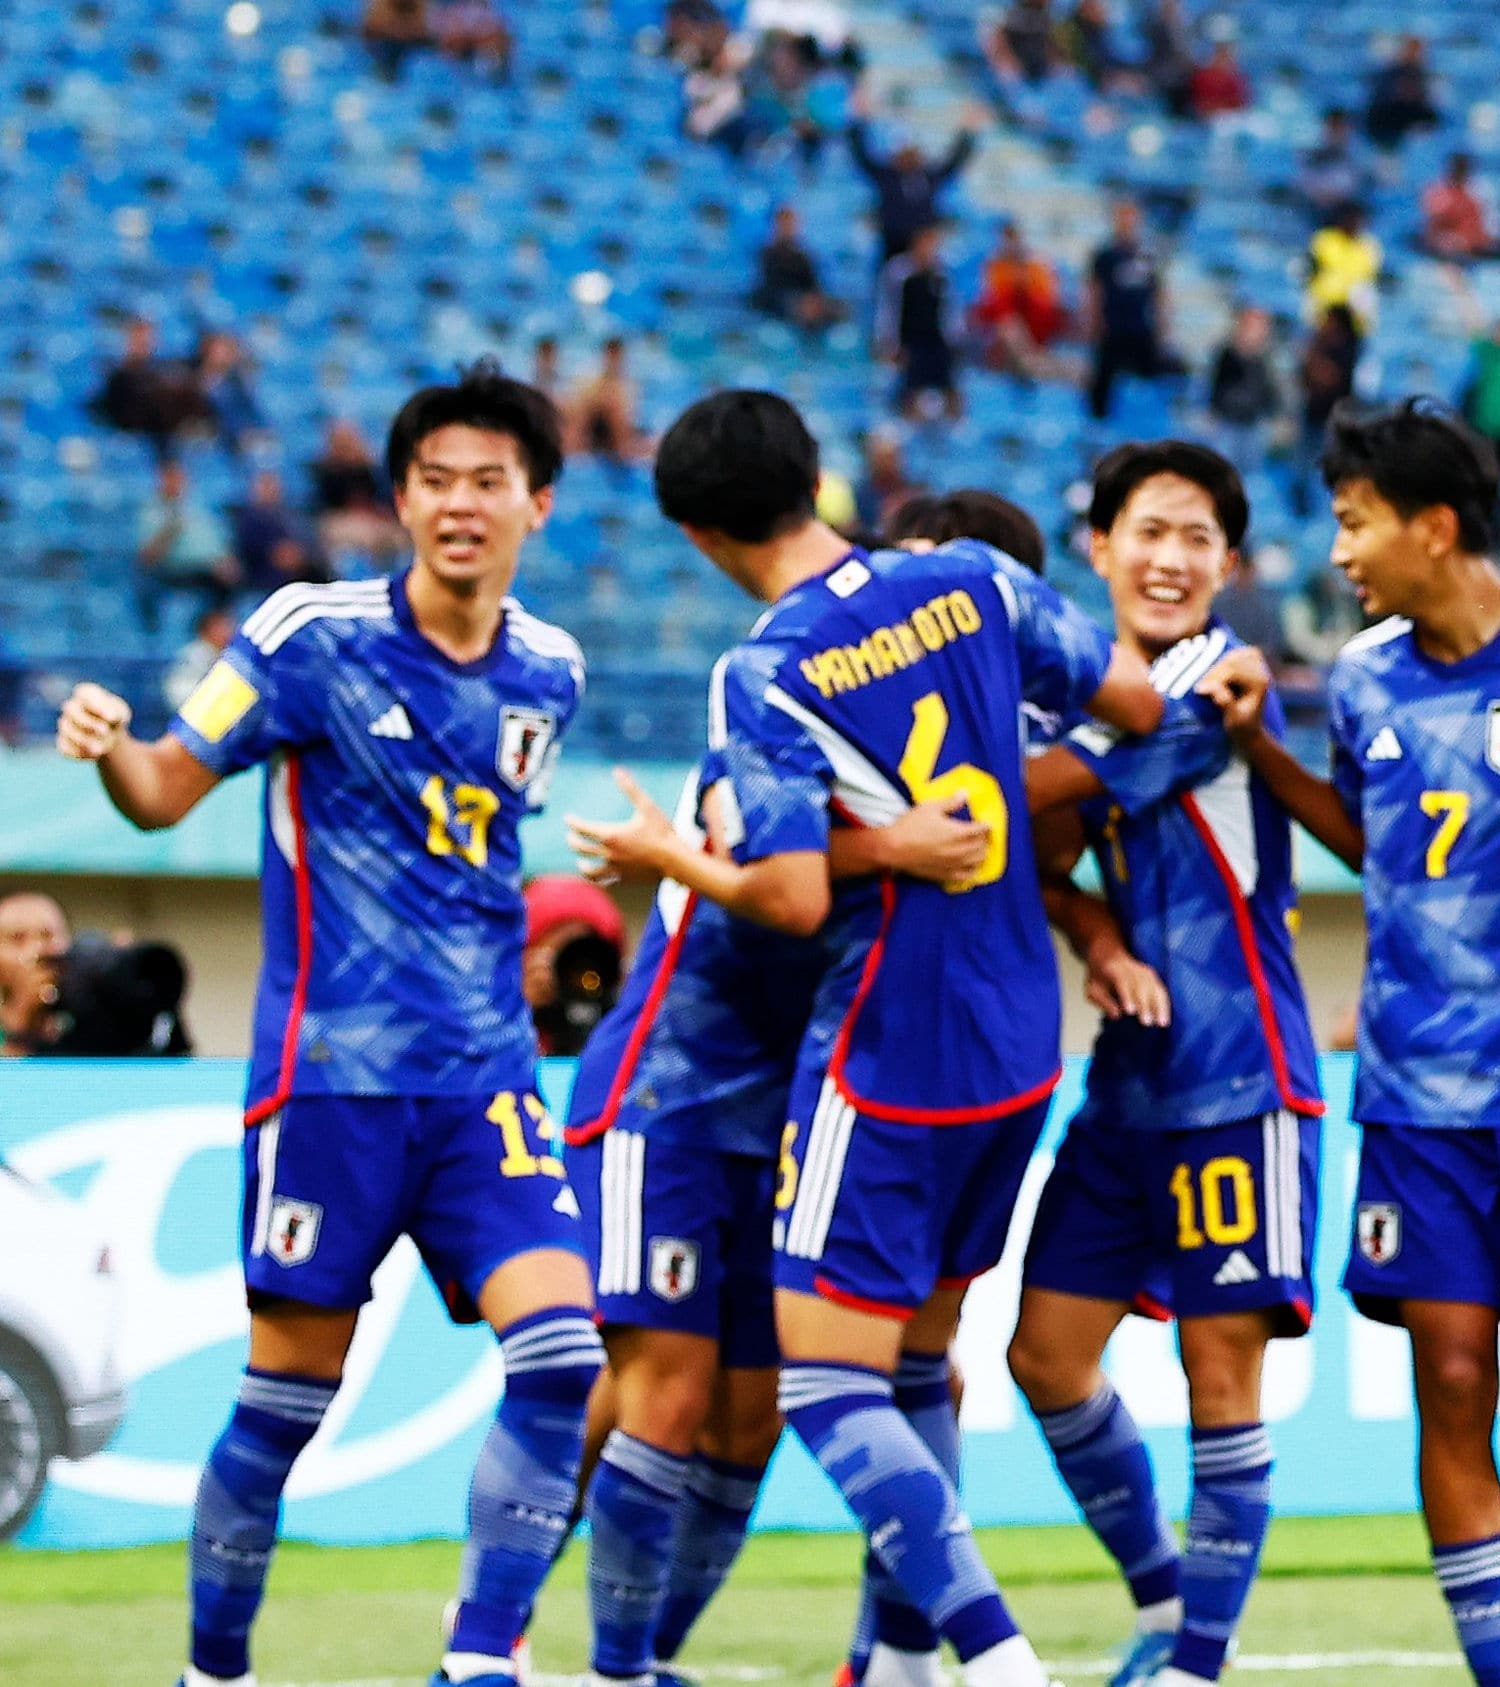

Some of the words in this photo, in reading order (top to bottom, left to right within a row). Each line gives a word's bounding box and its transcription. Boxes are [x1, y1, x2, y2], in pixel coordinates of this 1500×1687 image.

[899, 693, 1008, 893] 6
[1420, 790, 1470, 877] 7
[1170, 1155, 1256, 1250] 10
